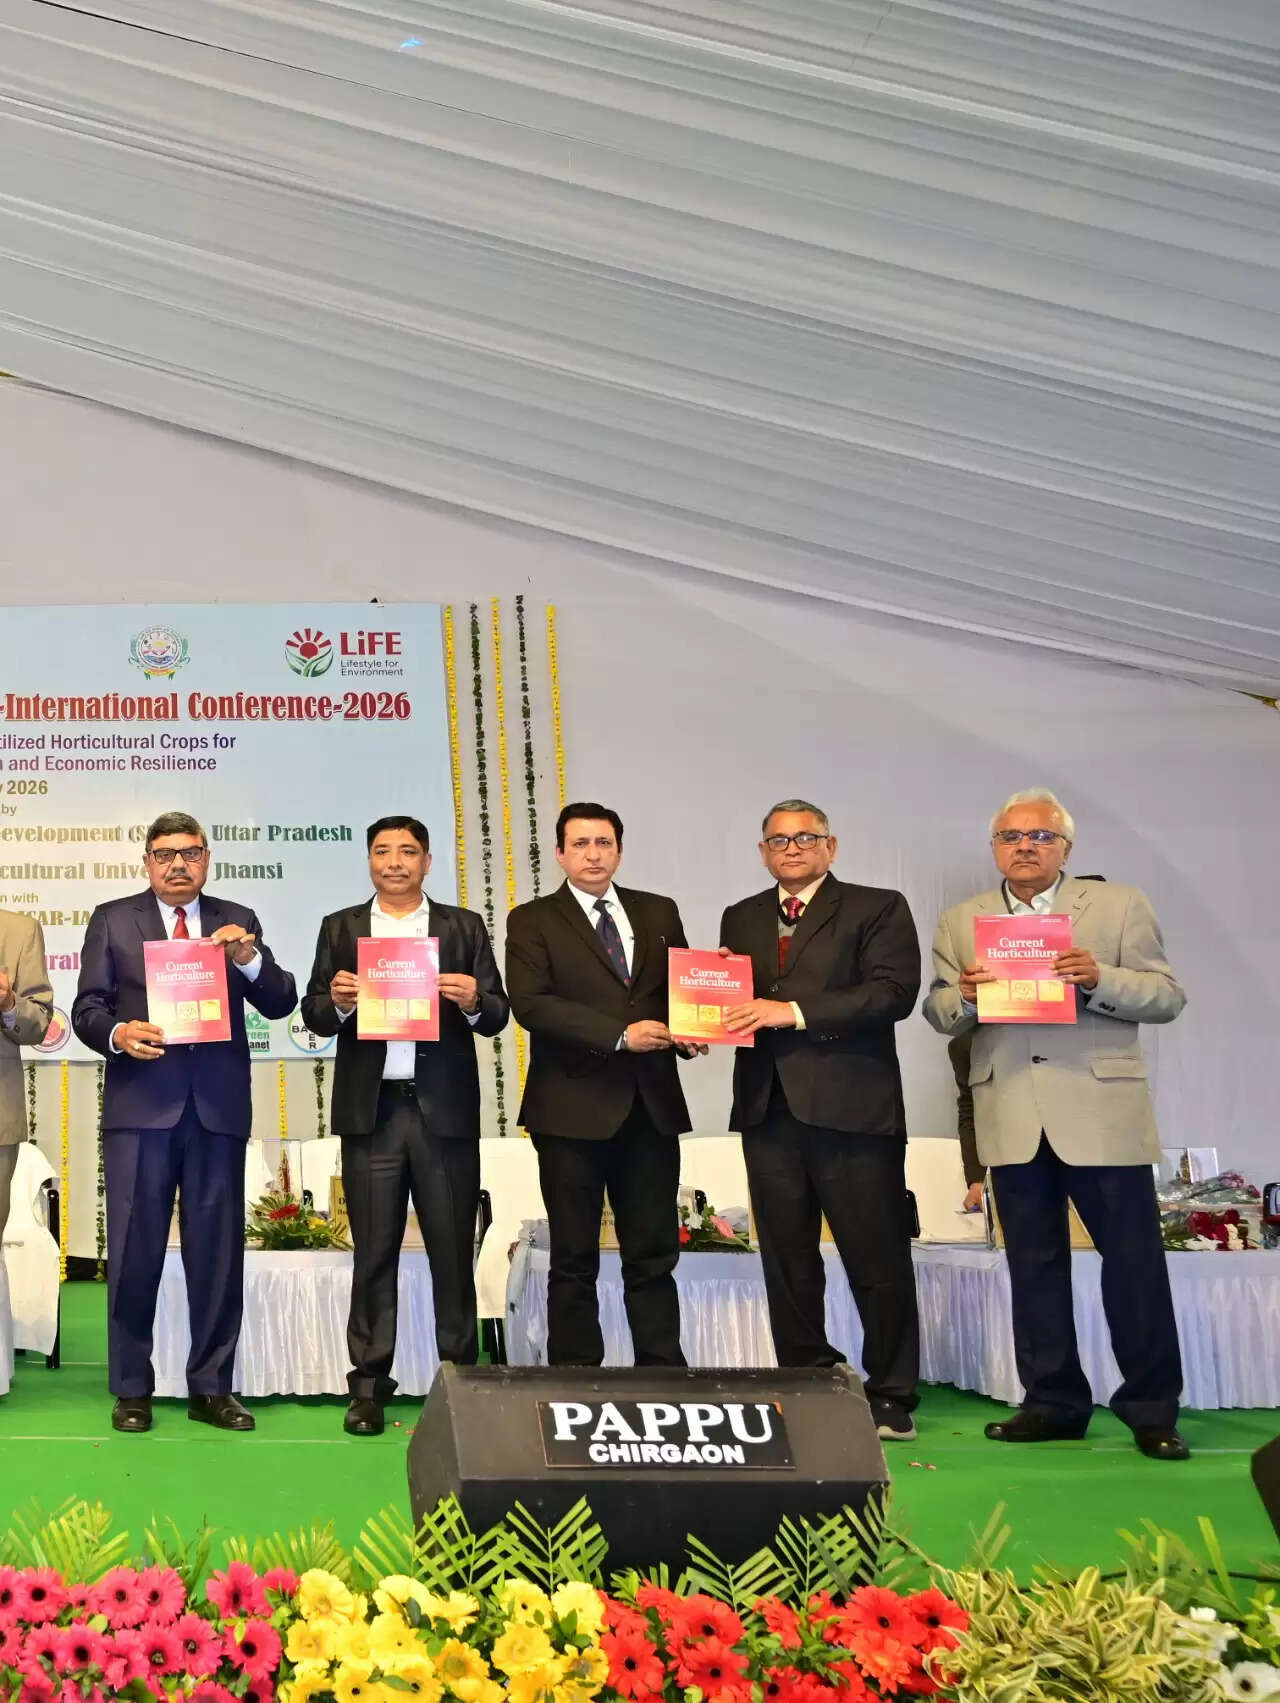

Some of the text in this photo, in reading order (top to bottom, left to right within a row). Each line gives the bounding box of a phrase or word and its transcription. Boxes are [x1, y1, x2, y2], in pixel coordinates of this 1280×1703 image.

[340, 630, 402, 655] LiFE
[341, 660, 381, 668] Lifestyle
[341, 668, 403, 676] Environment
[187, 691, 412, 721] Conference-2026
[51, 733, 154, 750] Horticultural
[159, 733, 208, 752] Crops
[213, 733, 236, 749] for
[8, 755, 40, 770] and
[45, 755, 126, 770] Economic
[131, 755, 217, 770] Resilience
[7, 780, 48, 795] 2026
[1, 803, 17, 816] by
[211, 824, 261, 841] Uttar
[267, 824, 353, 841] Pradesh
[213, 862, 283, 881] Jhansi
[12, 892, 39, 903] with
[999, 937, 1045, 948] Current
[166, 961, 203, 971] Current
[377, 958, 416, 968] Current
[156, 970, 215, 982] Horticulture
[368, 968, 427, 978] Horticulture
[690, 968, 729, 978] Current
[679, 976, 741, 988] Horticulture
[549, 1402, 772, 1443] PAPPU
[588, 1443, 745, 1464] CHIRGAON
